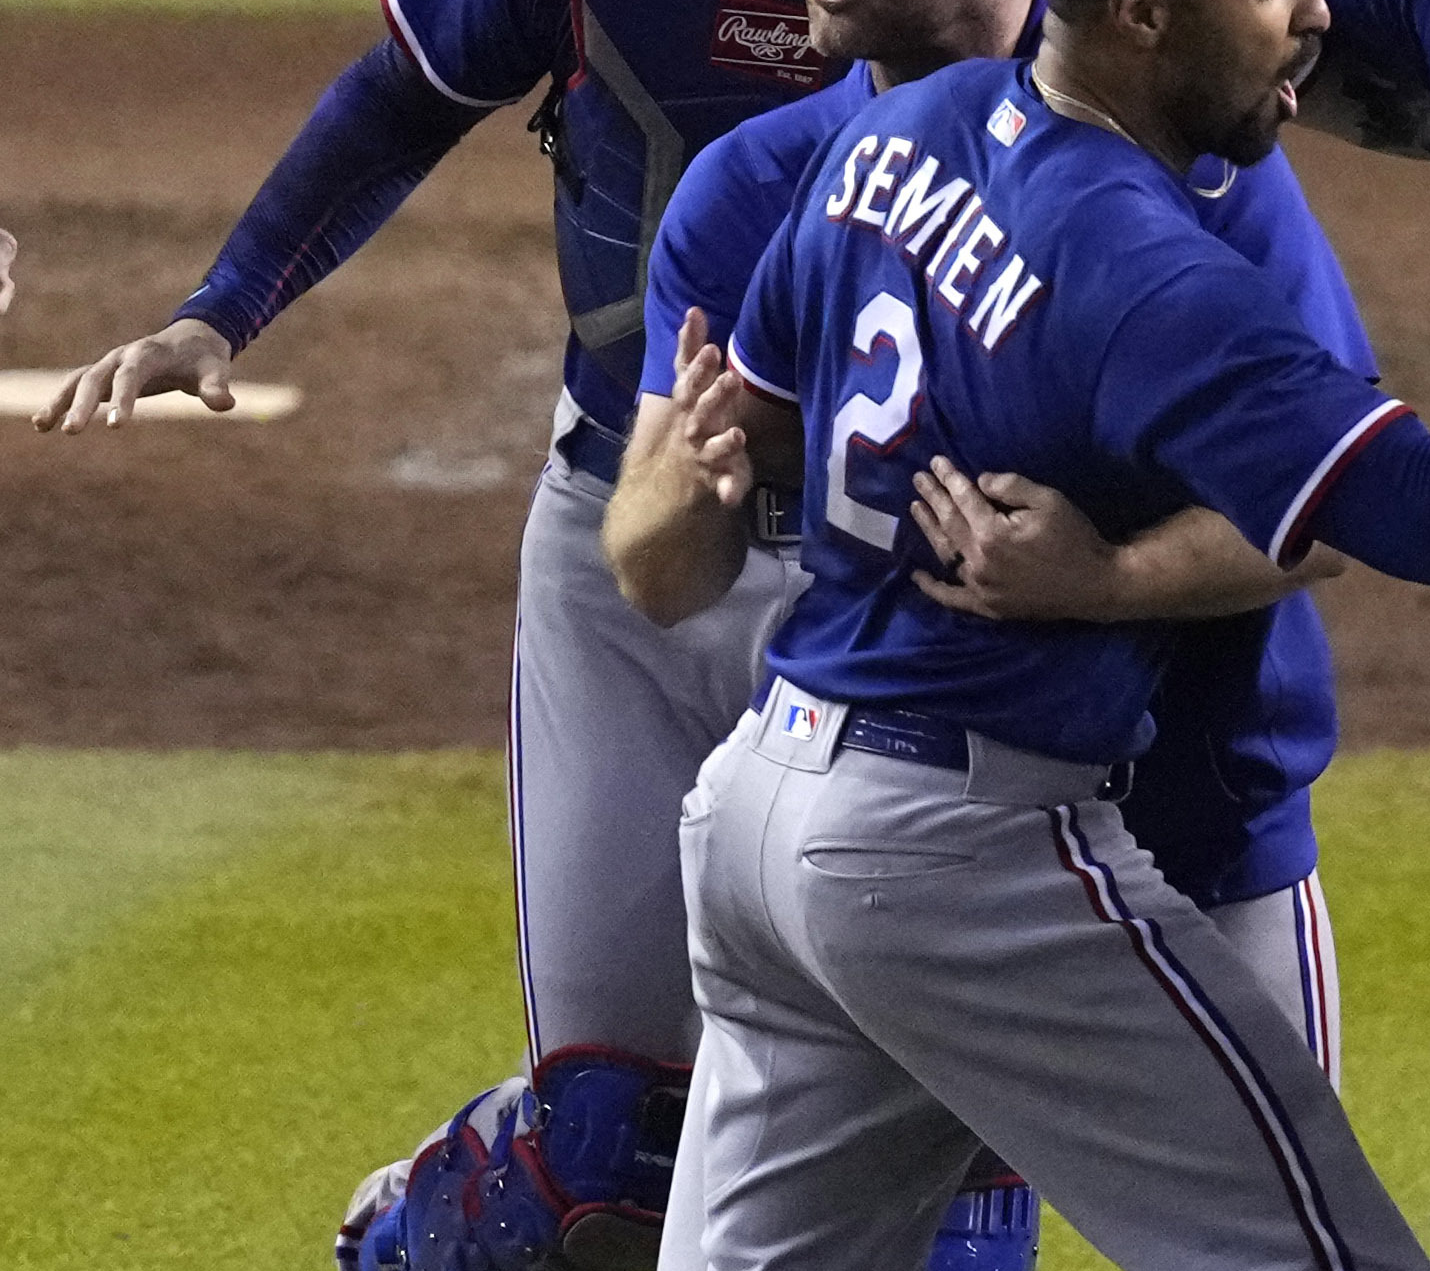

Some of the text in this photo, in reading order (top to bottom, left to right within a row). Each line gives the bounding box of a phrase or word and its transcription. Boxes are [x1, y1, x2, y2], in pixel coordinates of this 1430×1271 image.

[718, 15, 812, 60] Rawling
[826, 134, 1048, 359] SEMIEN
[824, 290, 926, 553] 2
